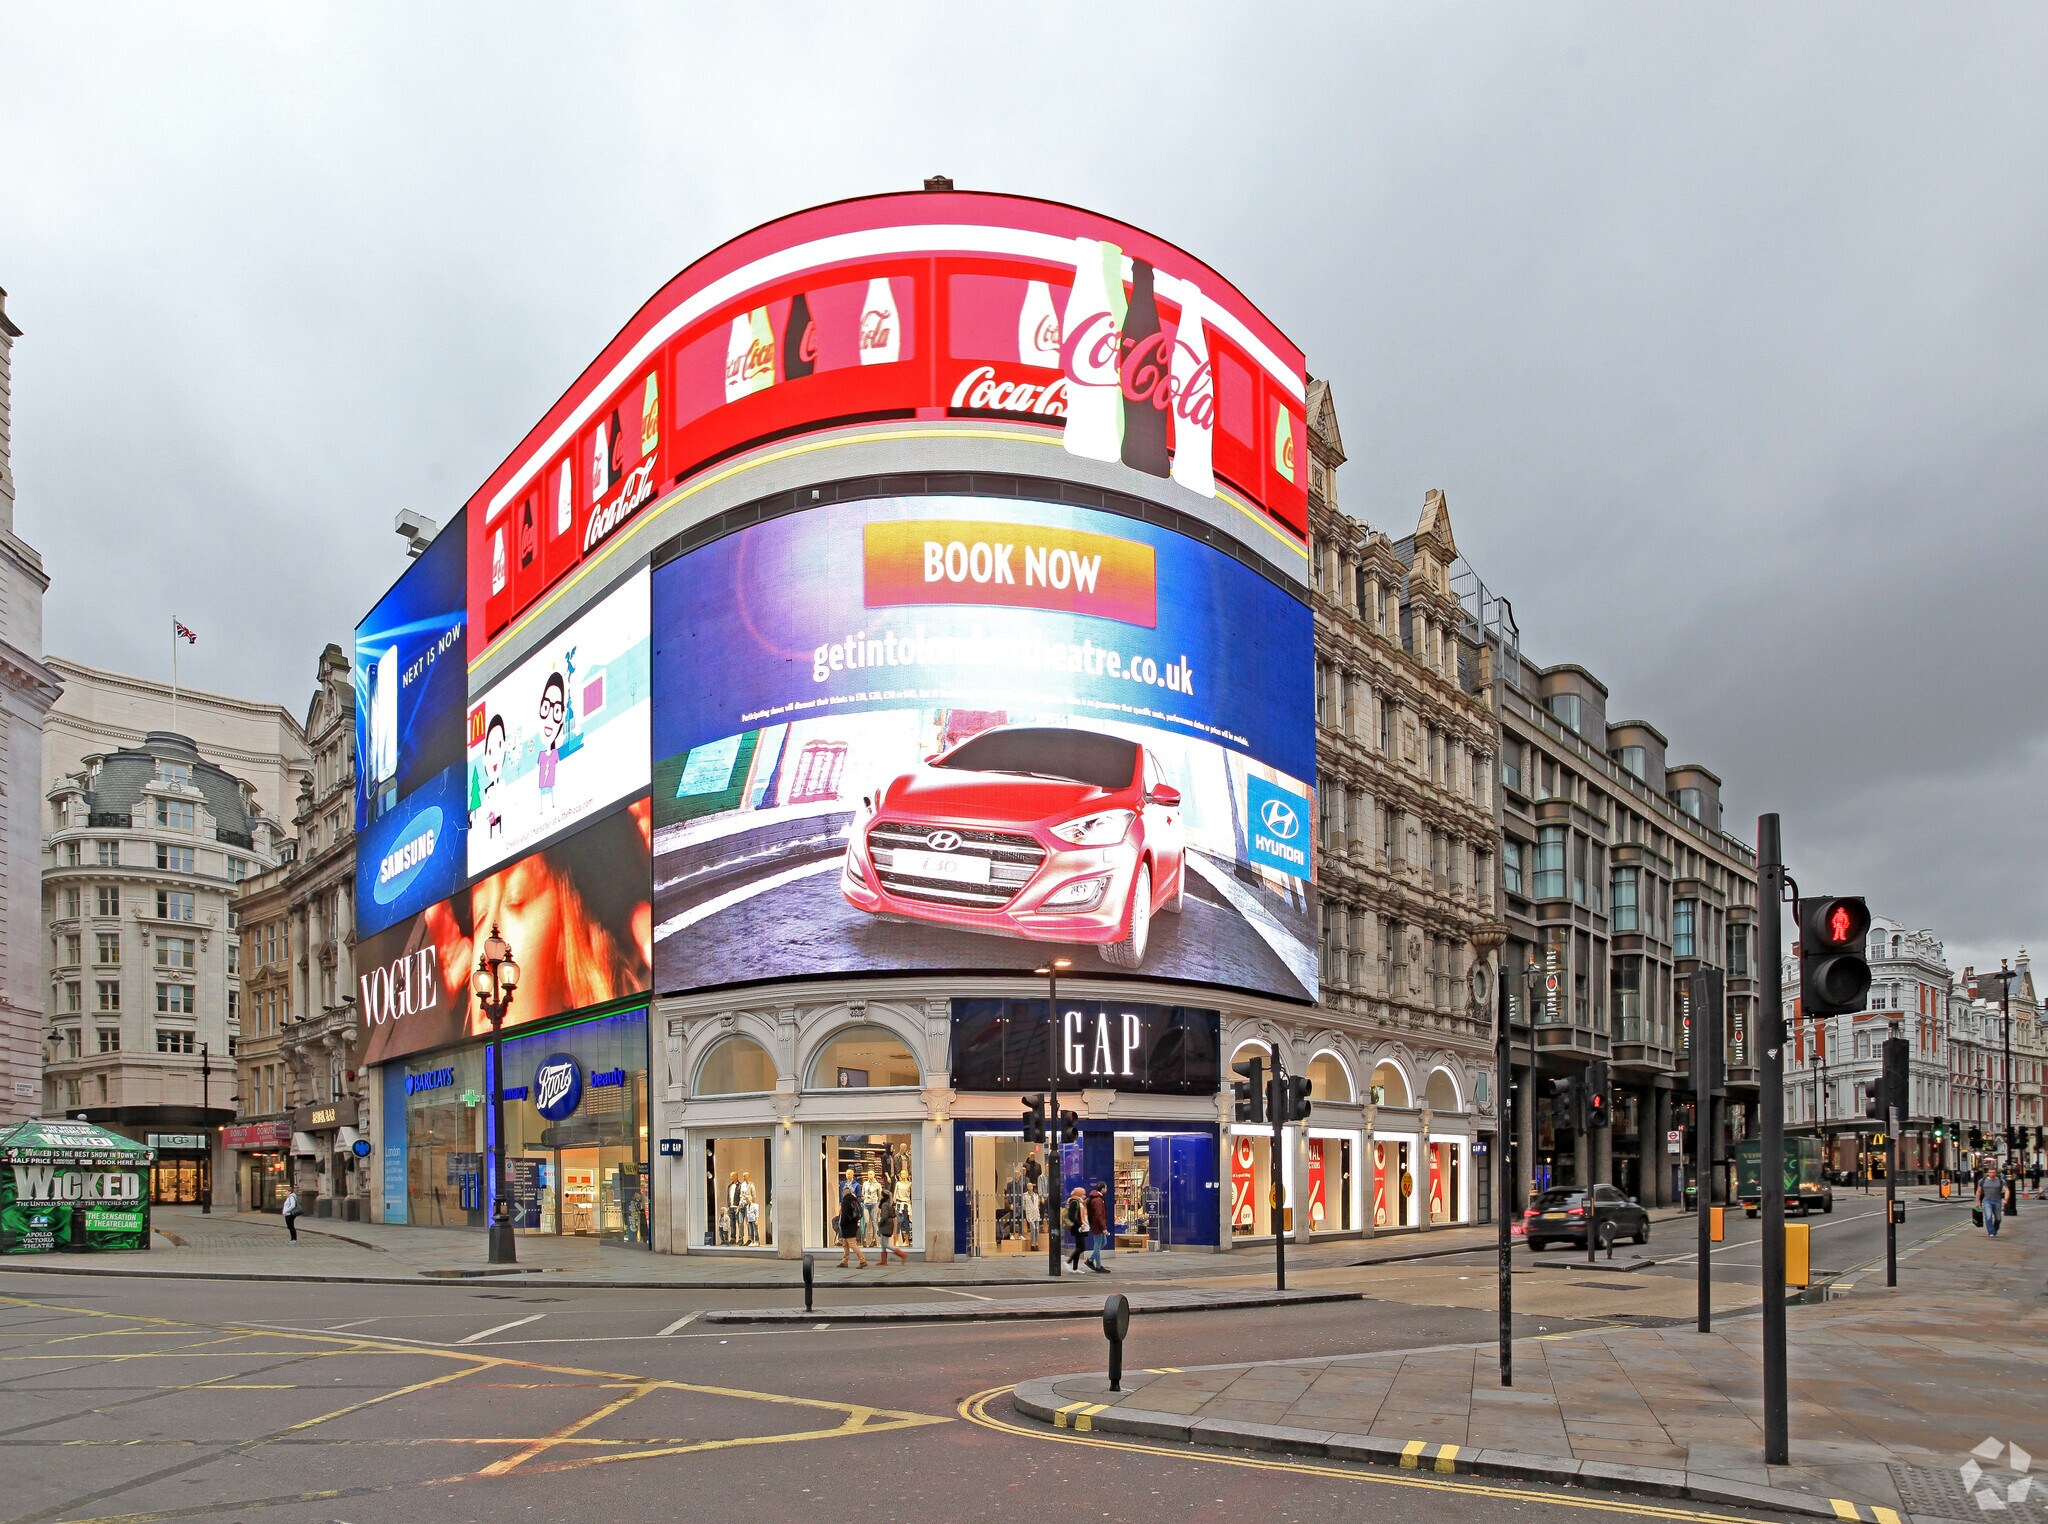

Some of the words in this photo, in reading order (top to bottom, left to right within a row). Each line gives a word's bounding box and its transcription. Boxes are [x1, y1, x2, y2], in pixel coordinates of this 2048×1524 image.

[584, 452, 658, 551] Coca-Cola
[924, 541, 1015, 585] BOOK
[1025, 545, 1101, 594] NOW
[402, 659, 424, 688] NEXT
[427, 646, 436, 664] IS
[438, 622, 461, 656] NOW
[742, 710, 770, 722] Participating
[770, 706, 784, 715] shows
[817, 698, 829, 707] their
[1122, 703, 1132, 712] that
[1166, 714, 1193, 726] performance
[380, 829, 435, 884] SAMSUNG
[1255, 834, 1304, 866] HYUNDAI
[360, 944, 437, 1028] VOGUE
[1546, 951, 1558, 991] CENTRE
[1547, 992, 1558, 1016] JAPAN
[1064, 1011, 1140, 1075] GAP
[414, 1067, 453, 1092] BARCLAYS
[536, 1063, 572, 1110] Boots
[590, 1067, 626, 1088] beauty
[167, 1136, 190, 1145] UGG
[230, 1128, 248, 1137] DONUTS
[1309, 1146, 1320, 1160] NAL
